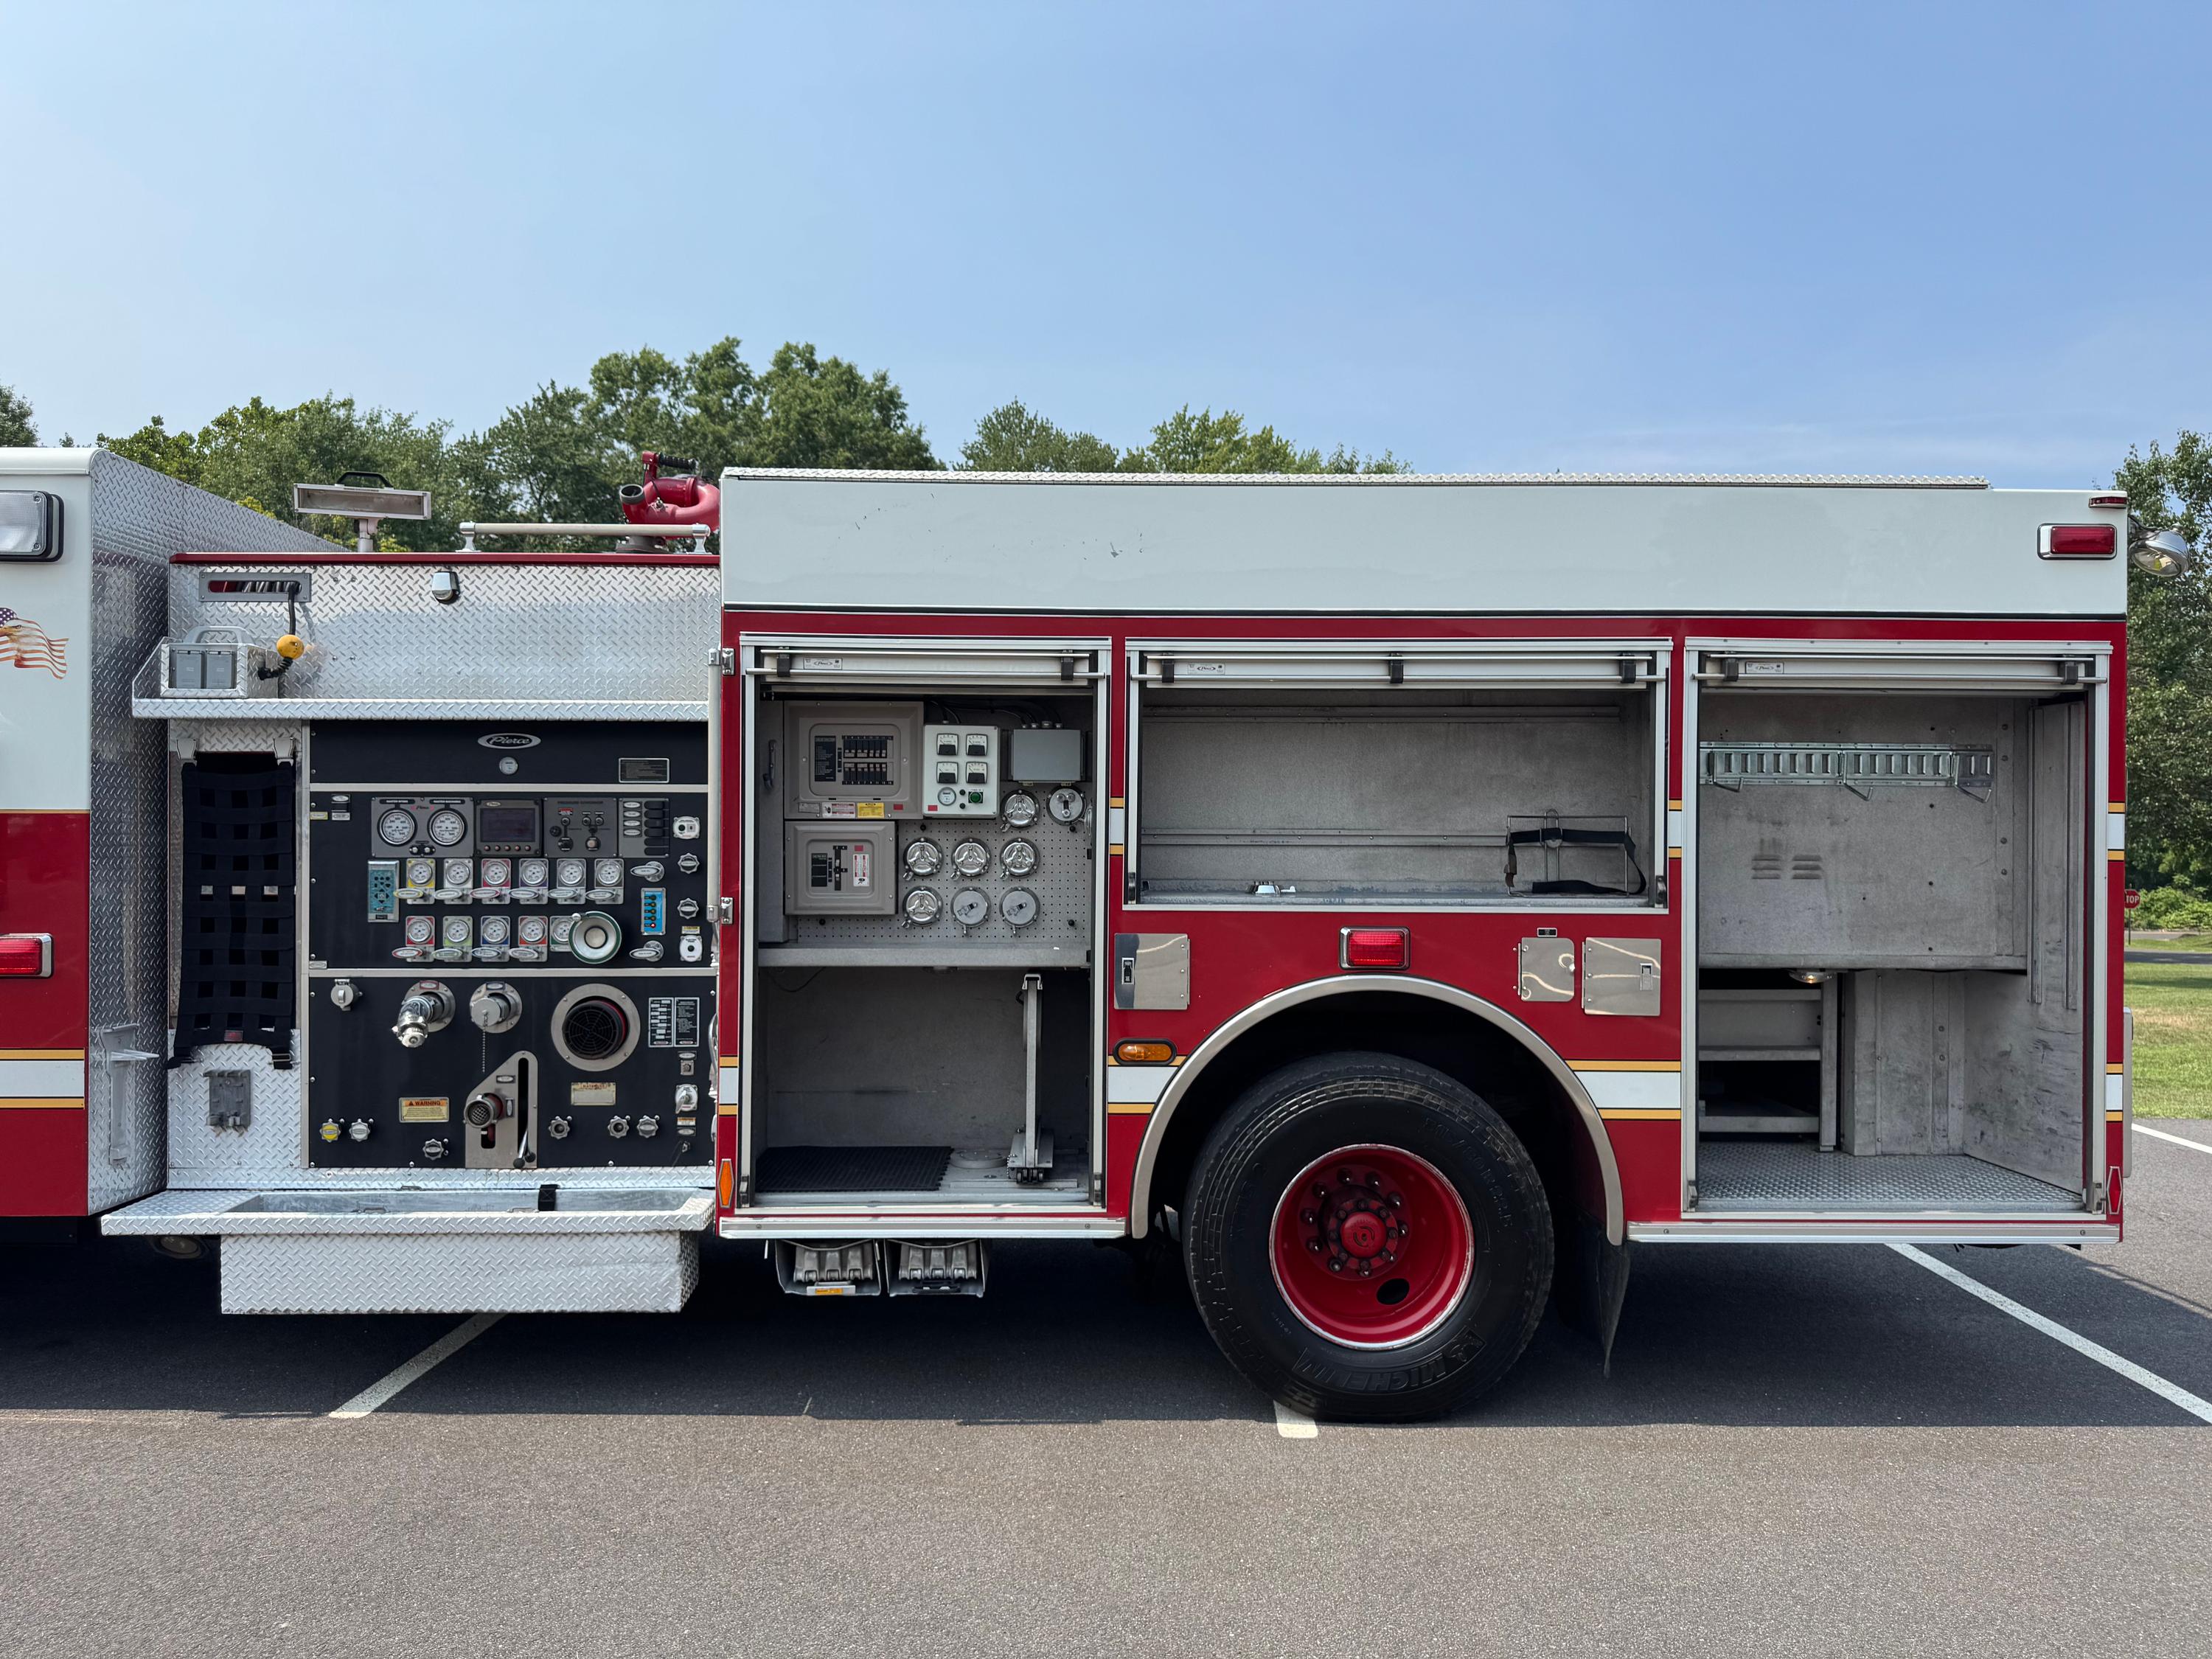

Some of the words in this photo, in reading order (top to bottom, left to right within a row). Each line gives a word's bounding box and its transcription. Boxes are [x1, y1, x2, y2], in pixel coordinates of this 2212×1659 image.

[490, 736, 529, 745] Pierce
[2126, 895, 2139, 903] TOP
[1299, 1357, 1446, 1391] MICHELIN
